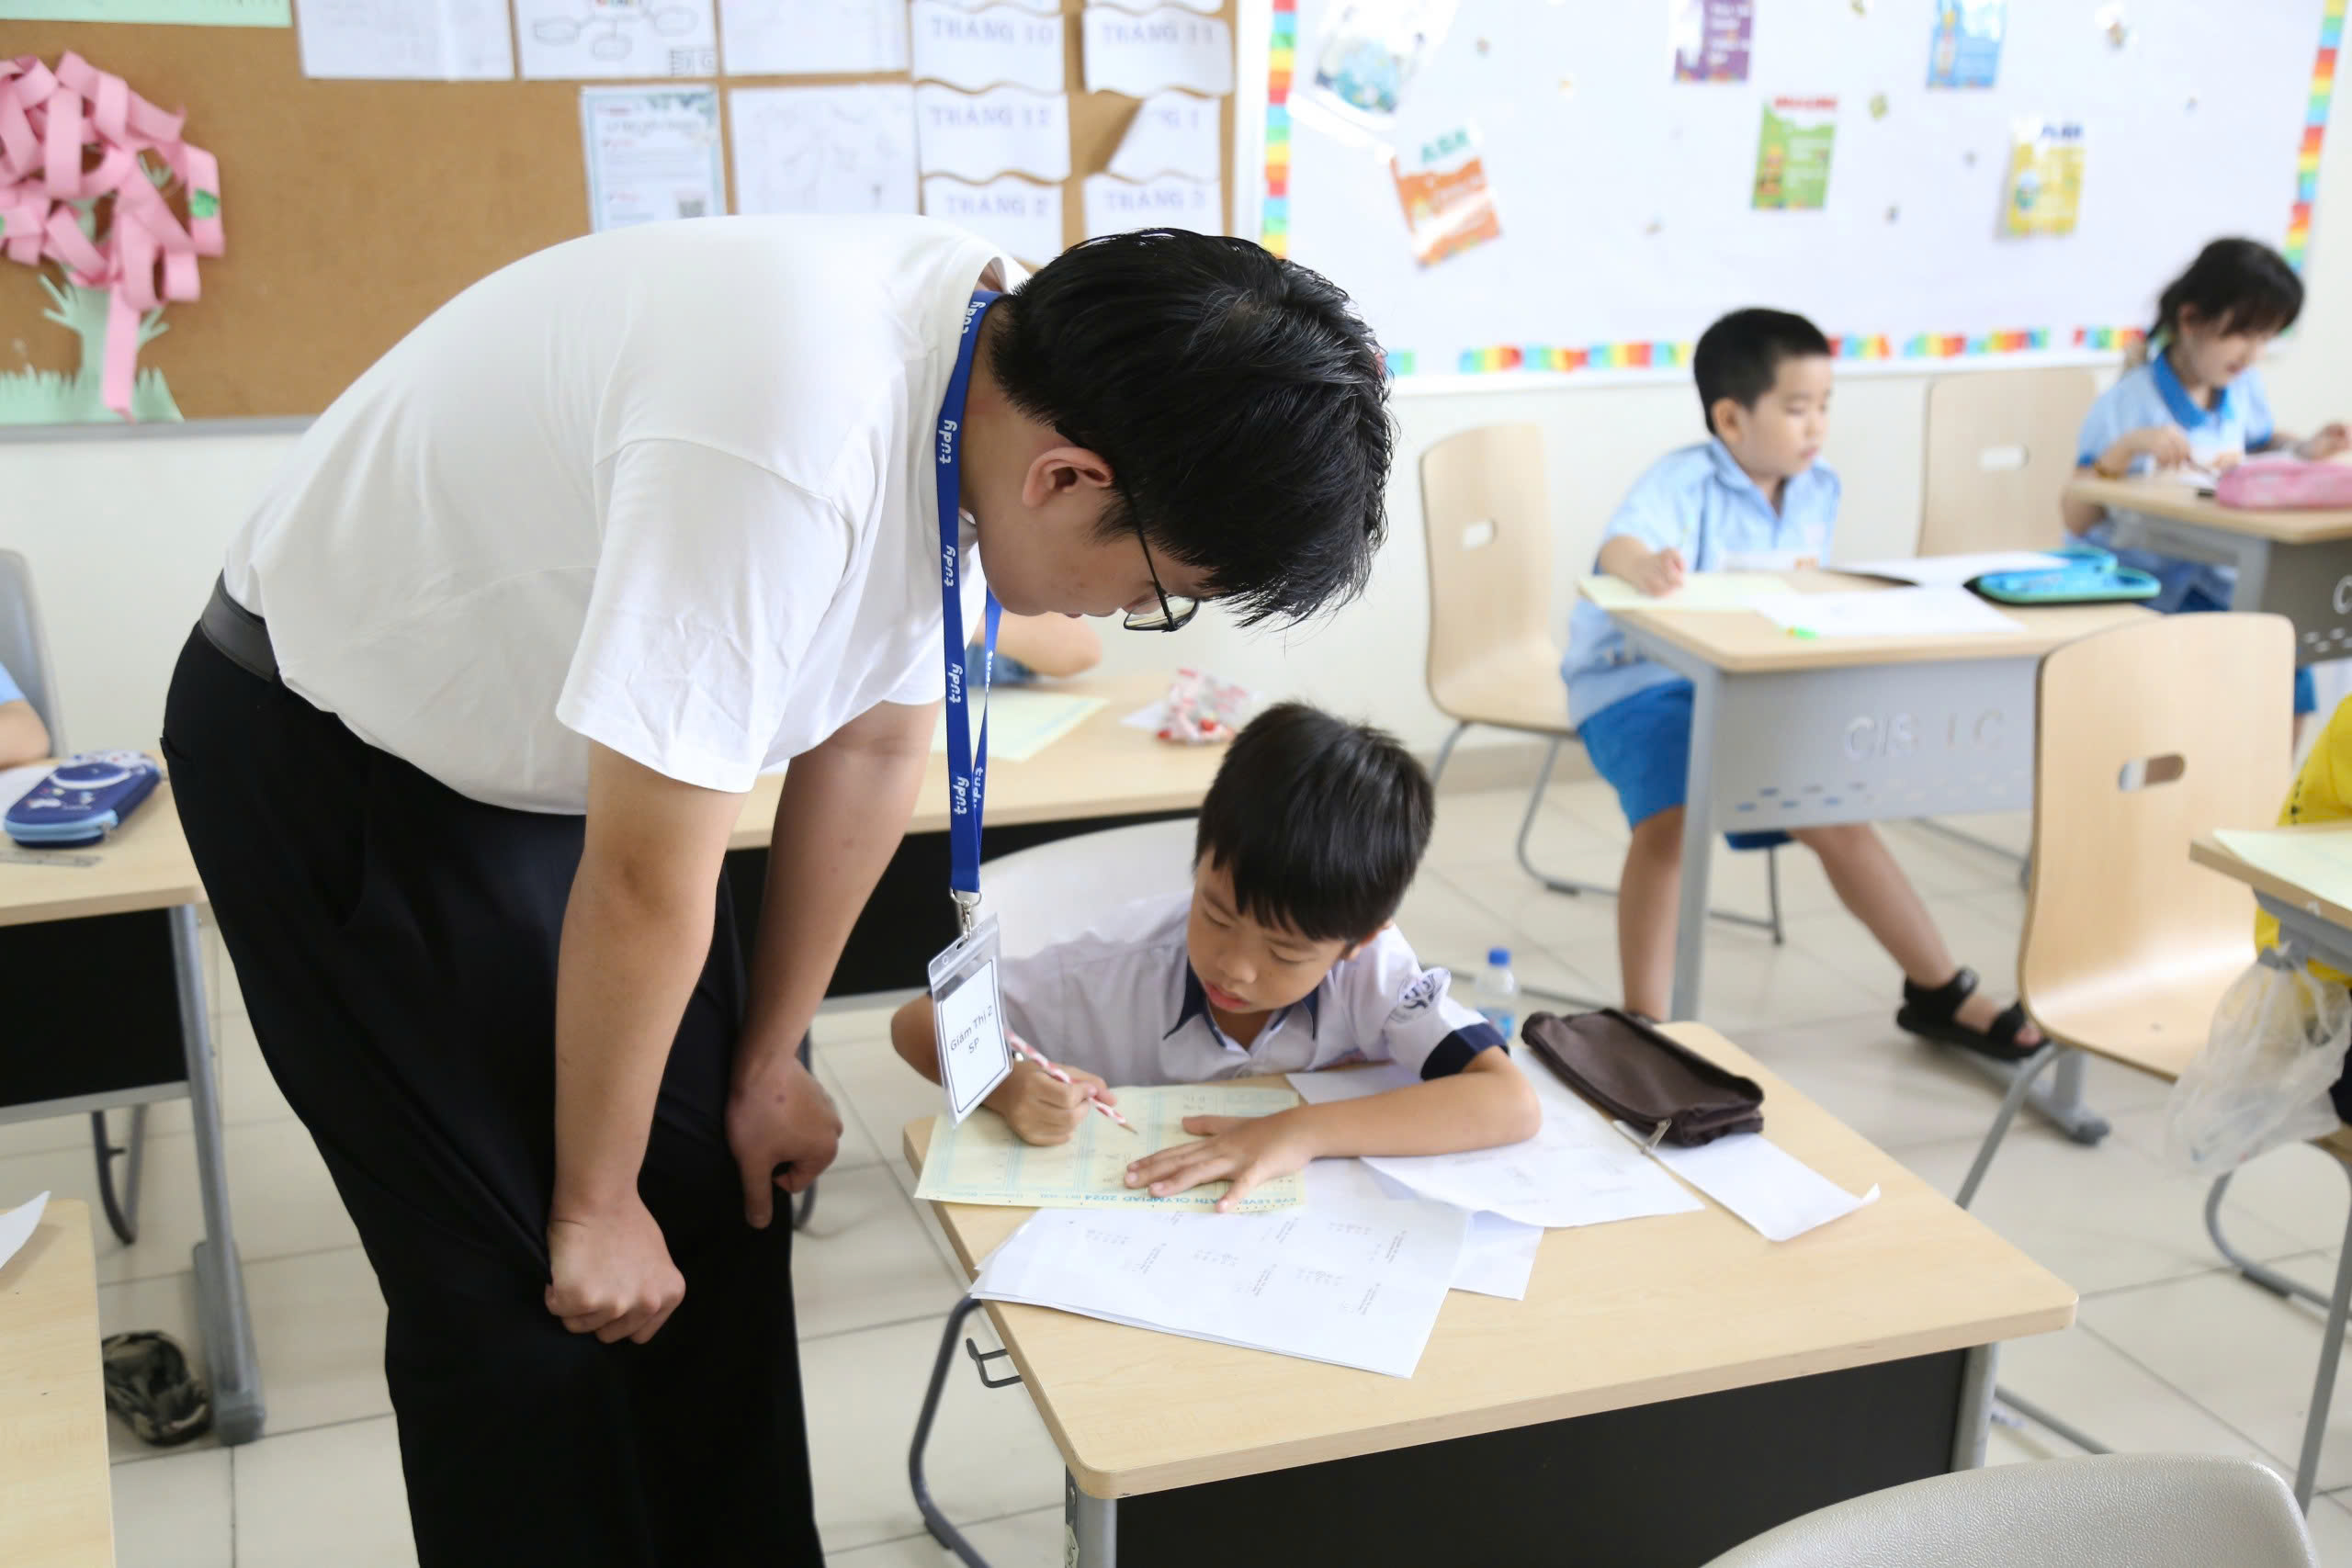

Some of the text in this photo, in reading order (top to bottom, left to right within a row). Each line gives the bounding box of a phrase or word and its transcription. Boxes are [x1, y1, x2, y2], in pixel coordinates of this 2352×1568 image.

[987, 1005, 993, 1017] 2
[968, 1037, 979, 1054] SP
[1084, 1194, 1118, 1202] 2024
[1123, 1195, 1191, 1205] OLYMPIAD
